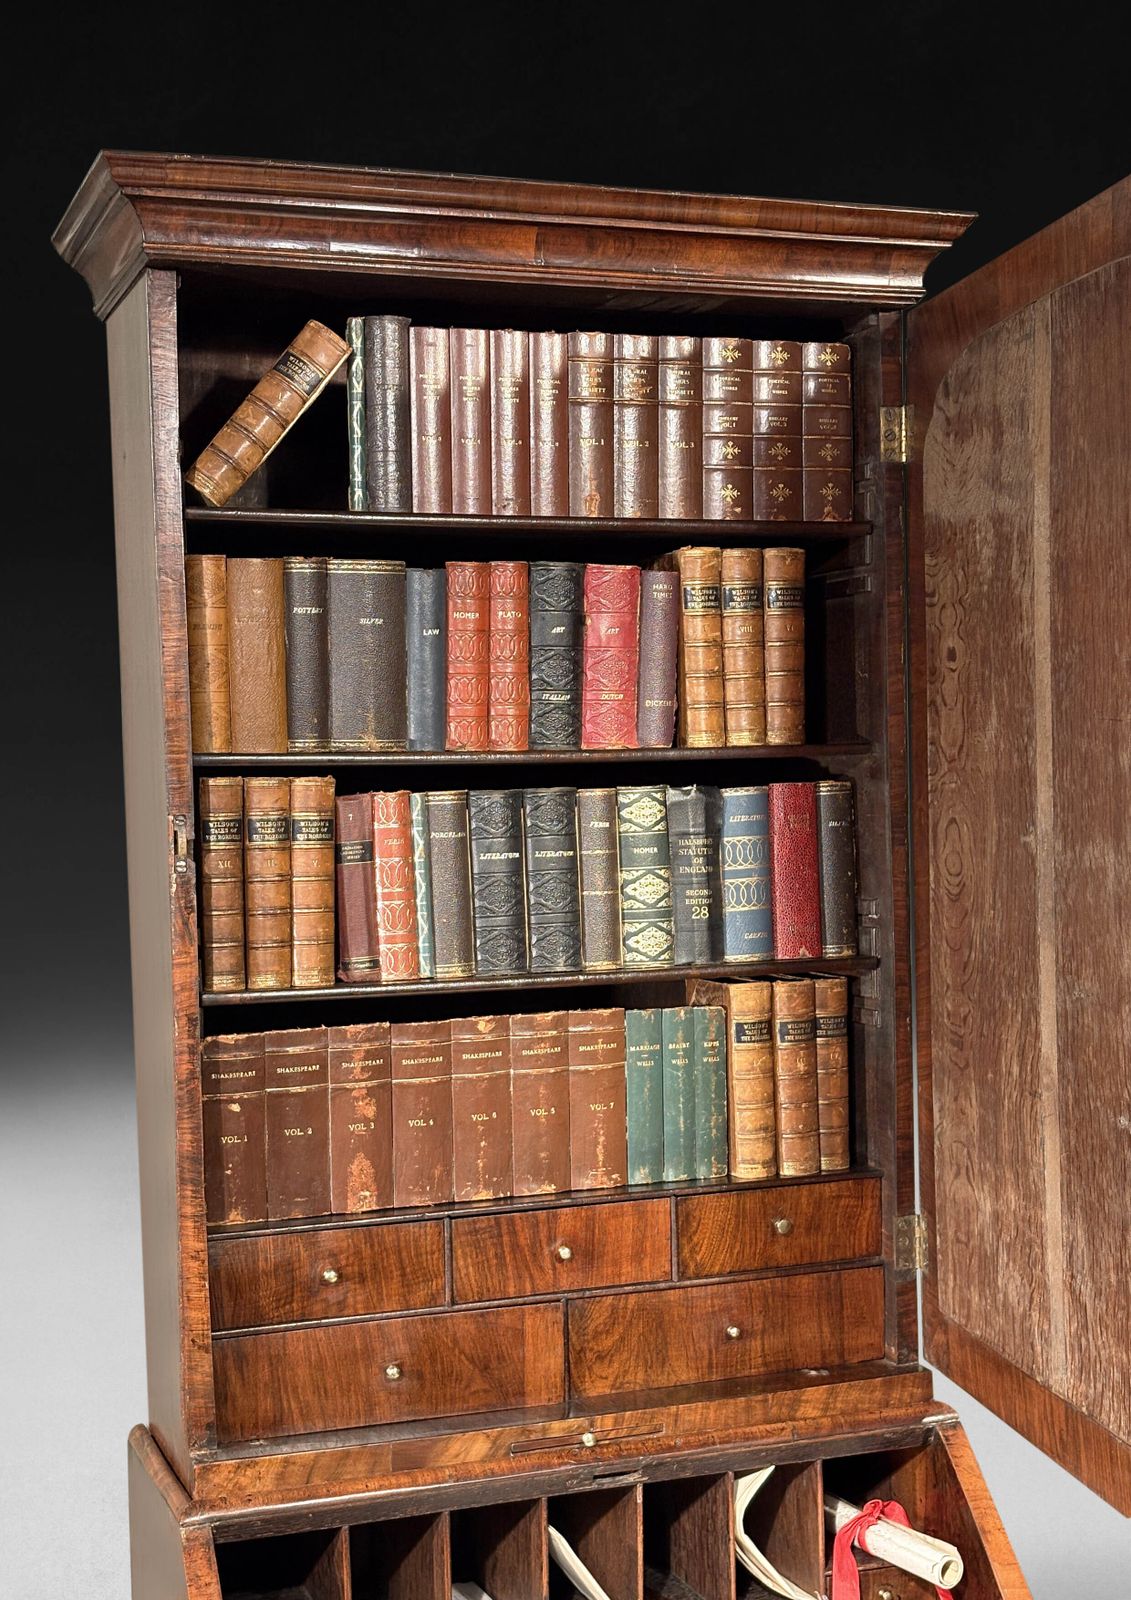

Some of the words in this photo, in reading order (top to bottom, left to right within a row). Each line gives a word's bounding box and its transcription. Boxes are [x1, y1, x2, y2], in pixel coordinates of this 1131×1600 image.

[453, 611, 480, 619] HOMER
[498, 611, 522, 619] PLATO
[423, 628, 440, 636] LAW
[551, 627, 566, 635] ART
[606, 627, 621, 635] ART
[601, 693, 625, 701] DUTCH
[634, 846, 659, 855] HOMER
[693, 856, 704, 865] OF
[691, 906, 709, 920] 28
[703, 1040, 721, 1049] KIPPS
[636, 1058, 655, 1067] WELLS
[671, 1057, 690, 1066] WELLS
[702, 1055, 721, 1064] WELLS
[276, 1064, 321, 1074] SHAKESPEARE
